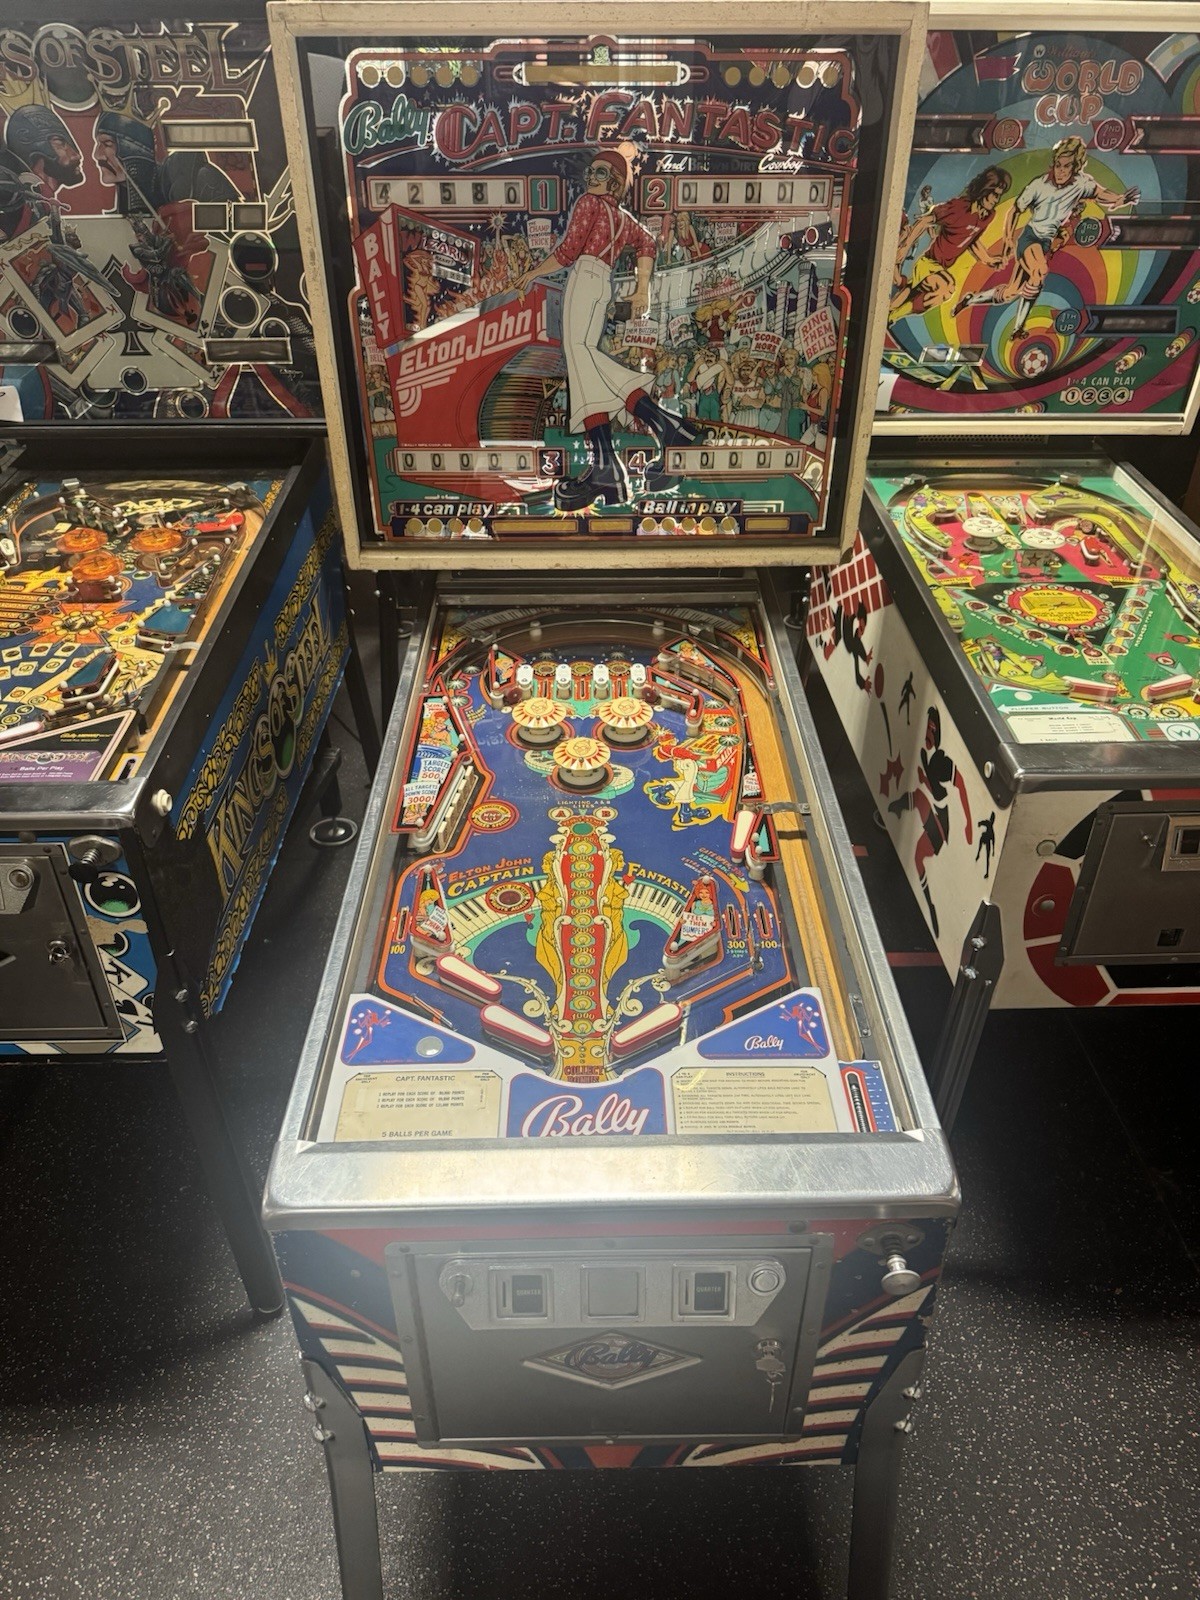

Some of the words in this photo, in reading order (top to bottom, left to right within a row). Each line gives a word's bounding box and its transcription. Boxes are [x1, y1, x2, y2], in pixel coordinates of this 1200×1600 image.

[40, 37, 82, 68] OF
[87, 28, 256, 94] STEEL
[1022, 60, 1144, 95] WORLD
[1034, 93, 1104, 127] CUP
[344, 94, 431, 156] Bally
[436, 104, 574, 160] CAPT.
[586, 91, 856, 160] FANTASTIC
[1101, 138, 1118, 147] UP
[655, 154, 689, 172] And
[758, 153, 803, 174] Cowboy
[537, 181, 549, 209] 1
[647, 179, 667, 208] 2
[1080, 235, 1095, 243] UP
[363, 233, 390, 340] BALLY
[801, 310, 828, 336] RING
[625, 334, 656, 345] CHAMP
[804, 322, 833, 347] THEM
[805, 334, 836, 360] BELLS
[1091, 377, 1109, 386] CAN
[1113, 376, 1136, 386] PLAY
[541, 451, 560, 475] 3
[628, 450, 647, 474] 4
[422, 503, 454, 516] can
[456, 503, 494, 519] play
[643, 500, 677, 514] Ball
[680, 501, 696, 514] in
[697, 500, 738, 517] play
[423, 766, 445, 774] SCORE
[424, 760, 451, 769] TARGETS
[407, 795, 435, 805] 3000!
[555, 810, 566, 818] A
[601, 810, 611, 818] B
[447, 866, 534, 897] CAPTAIN
[626, 861, 691, 898] FANTASTI
[686, 913, 703, 921] FEEL
[390, 945, 406, 955] 100
[727, 940, 746, 949] 300
[571, 967, 594, 975] 3000
[744, 1035, 784, 1051] Bally
[417, 1074, 456, 1082] FANTASTIC
[564, 1065, 604, 1076] COLLECT
[521, 1093, 650, 1138] Bally
[564, 1342, 661, 1369] Bally
